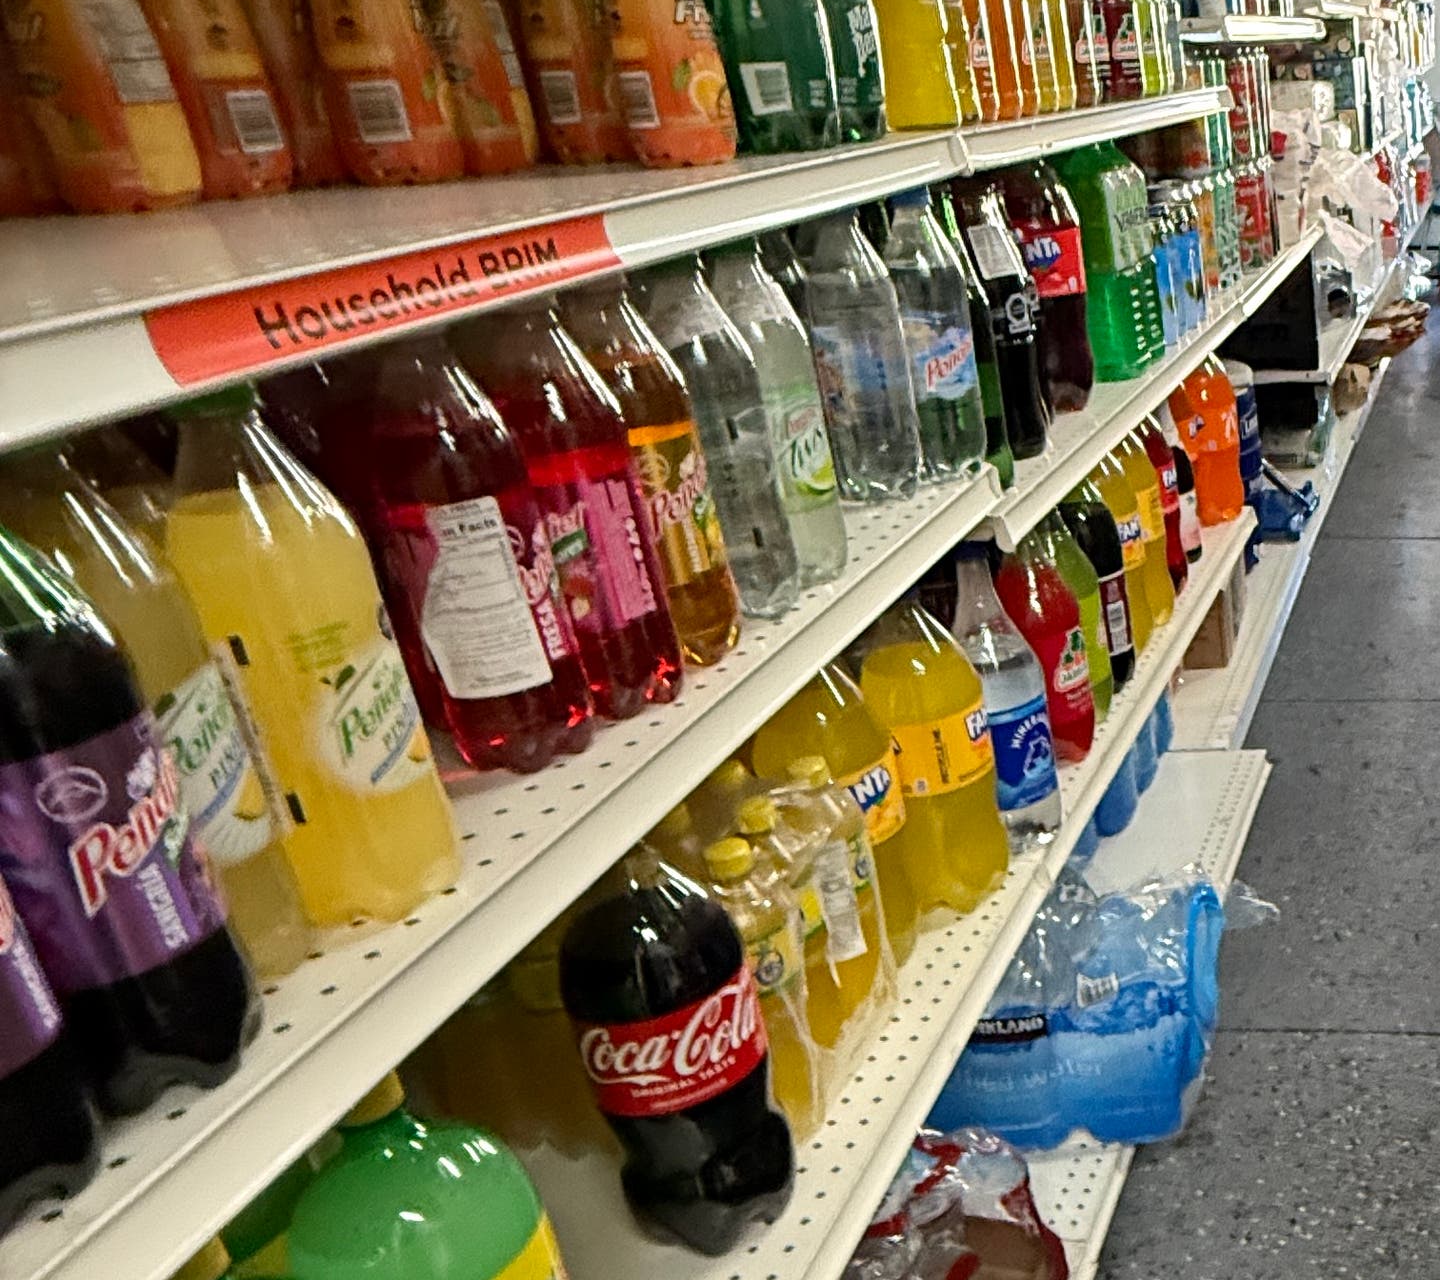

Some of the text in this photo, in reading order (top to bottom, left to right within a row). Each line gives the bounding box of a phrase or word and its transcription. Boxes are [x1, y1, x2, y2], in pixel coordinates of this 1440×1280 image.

[1024, 236, 1062, 263] NTA
[252, 257, 479, 350] Household
[850, 764, 892, 806] NTA
[580, 977, 757, 1086] Coca-Cola
